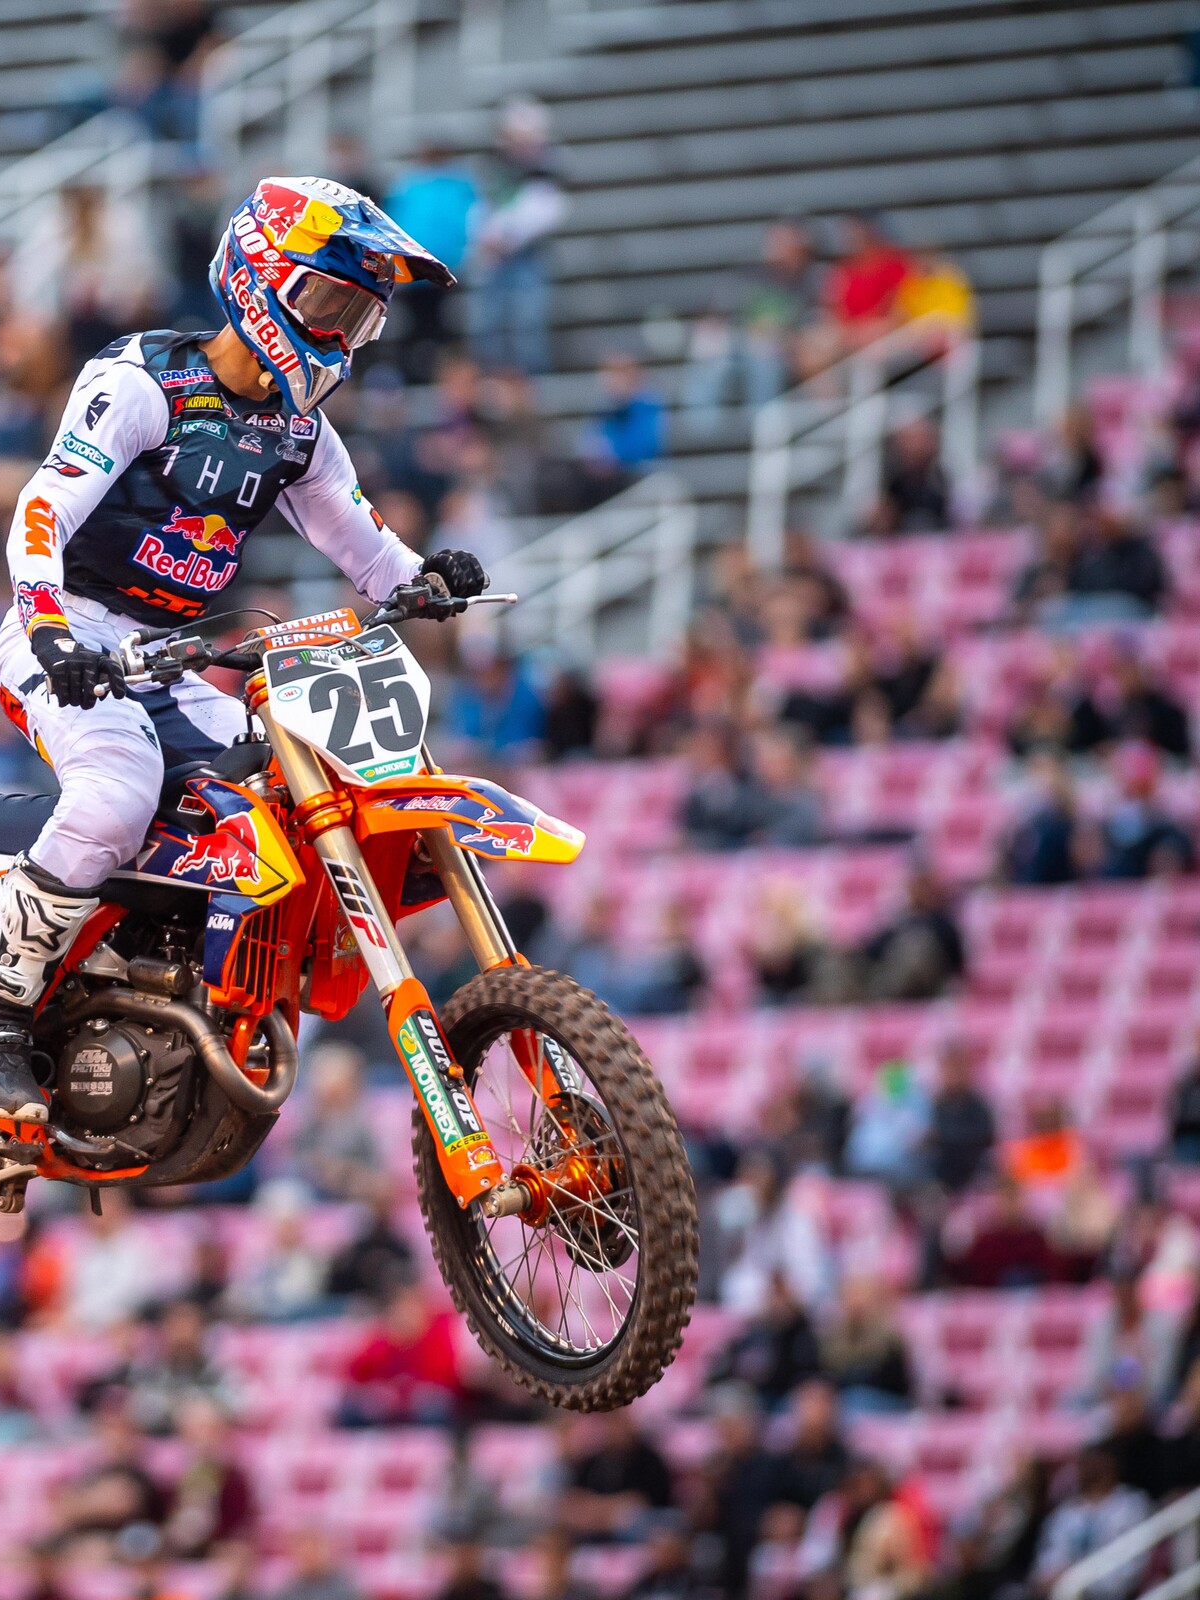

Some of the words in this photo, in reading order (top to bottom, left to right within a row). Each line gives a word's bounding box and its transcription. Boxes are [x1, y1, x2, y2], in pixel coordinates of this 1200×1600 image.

[233, 206, 291, 281] 100%
[292, 252, 317, 264] AIROH
[159, 367, 211, 382] PARTS
[263, 608, 350, 635] RENTHAL
[309, 657, 424, 766] 25
[374, 759, 413, 775] MOTOREX
[206, 913, 235, 931] KTM
[74, 1049, 108, 1064] KTM
[70, 1063, 113, 1073] FACTORY
[409, 1055, 459, 1143] MOTOREX
